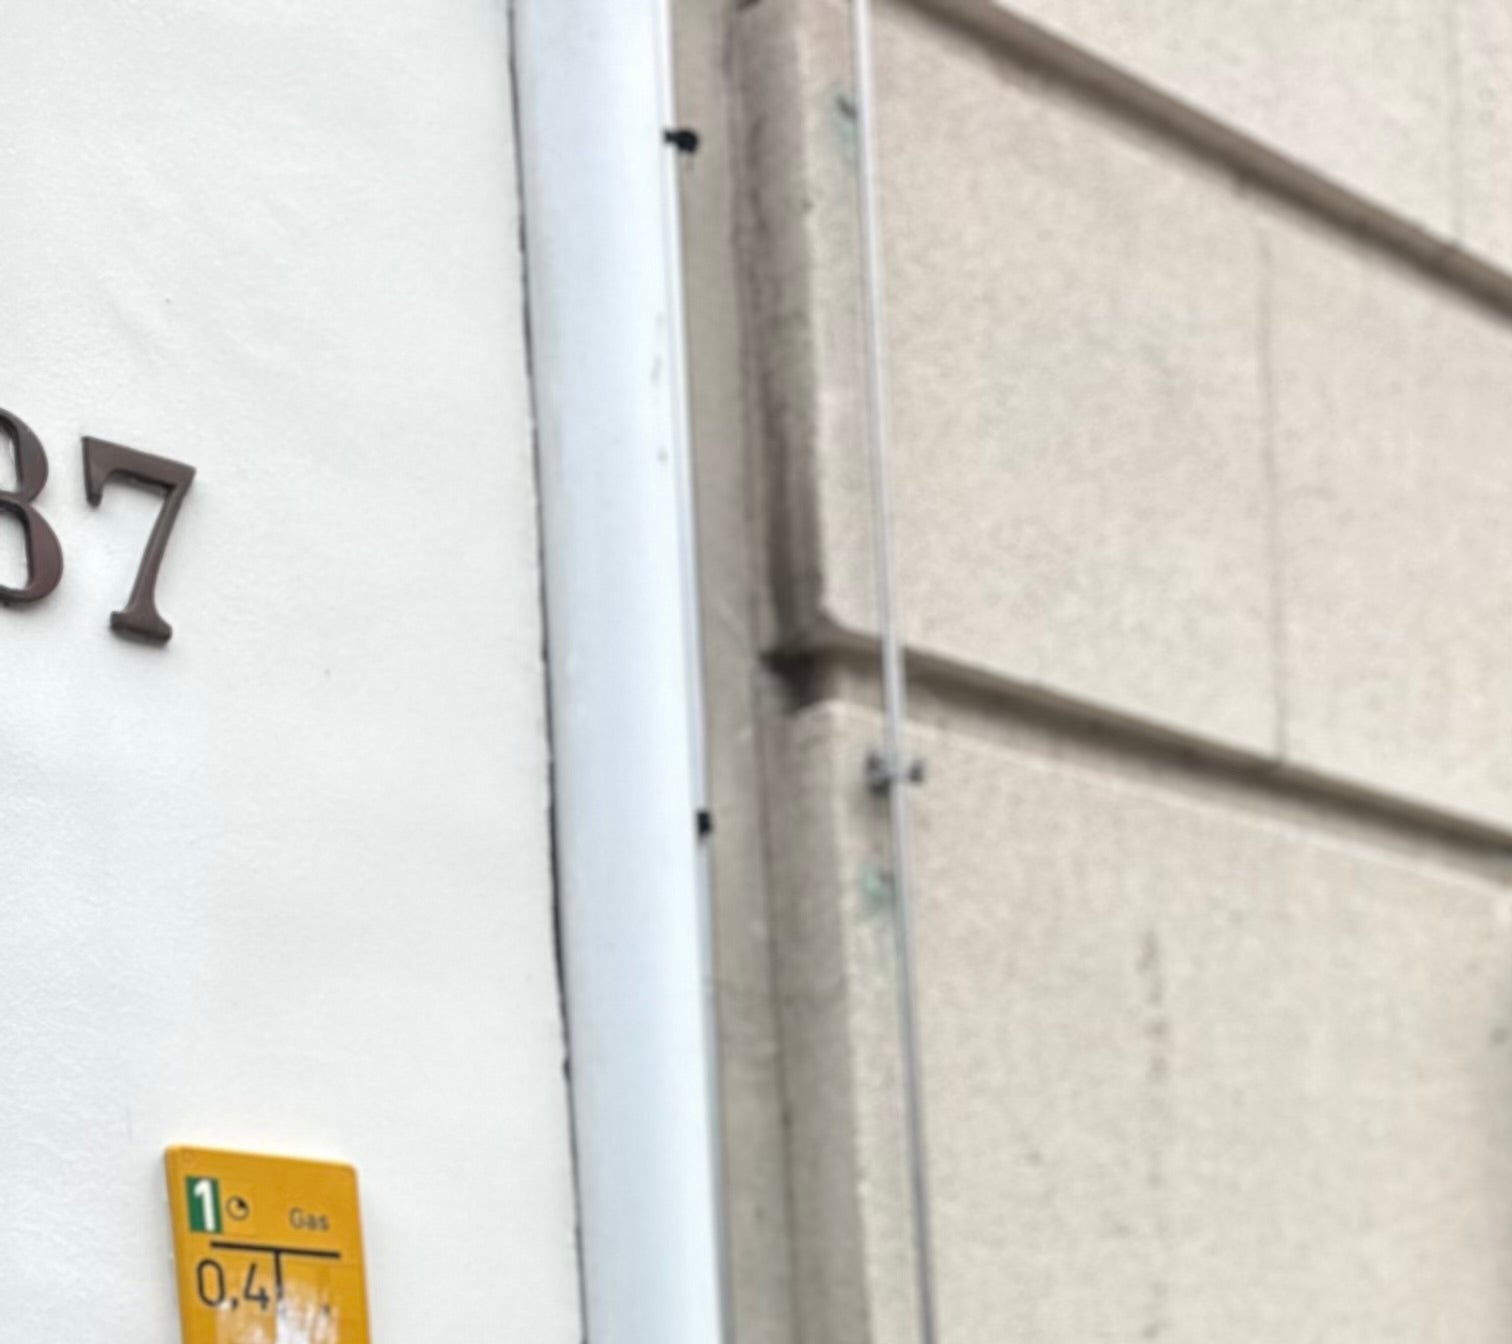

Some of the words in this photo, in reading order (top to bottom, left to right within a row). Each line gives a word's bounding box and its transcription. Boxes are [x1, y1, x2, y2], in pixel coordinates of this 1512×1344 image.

[193, 1178, 216, 1232] 1
[289, 1207, 330, 1231] Gas
[196, 1258, 270, 1310] 0,4
